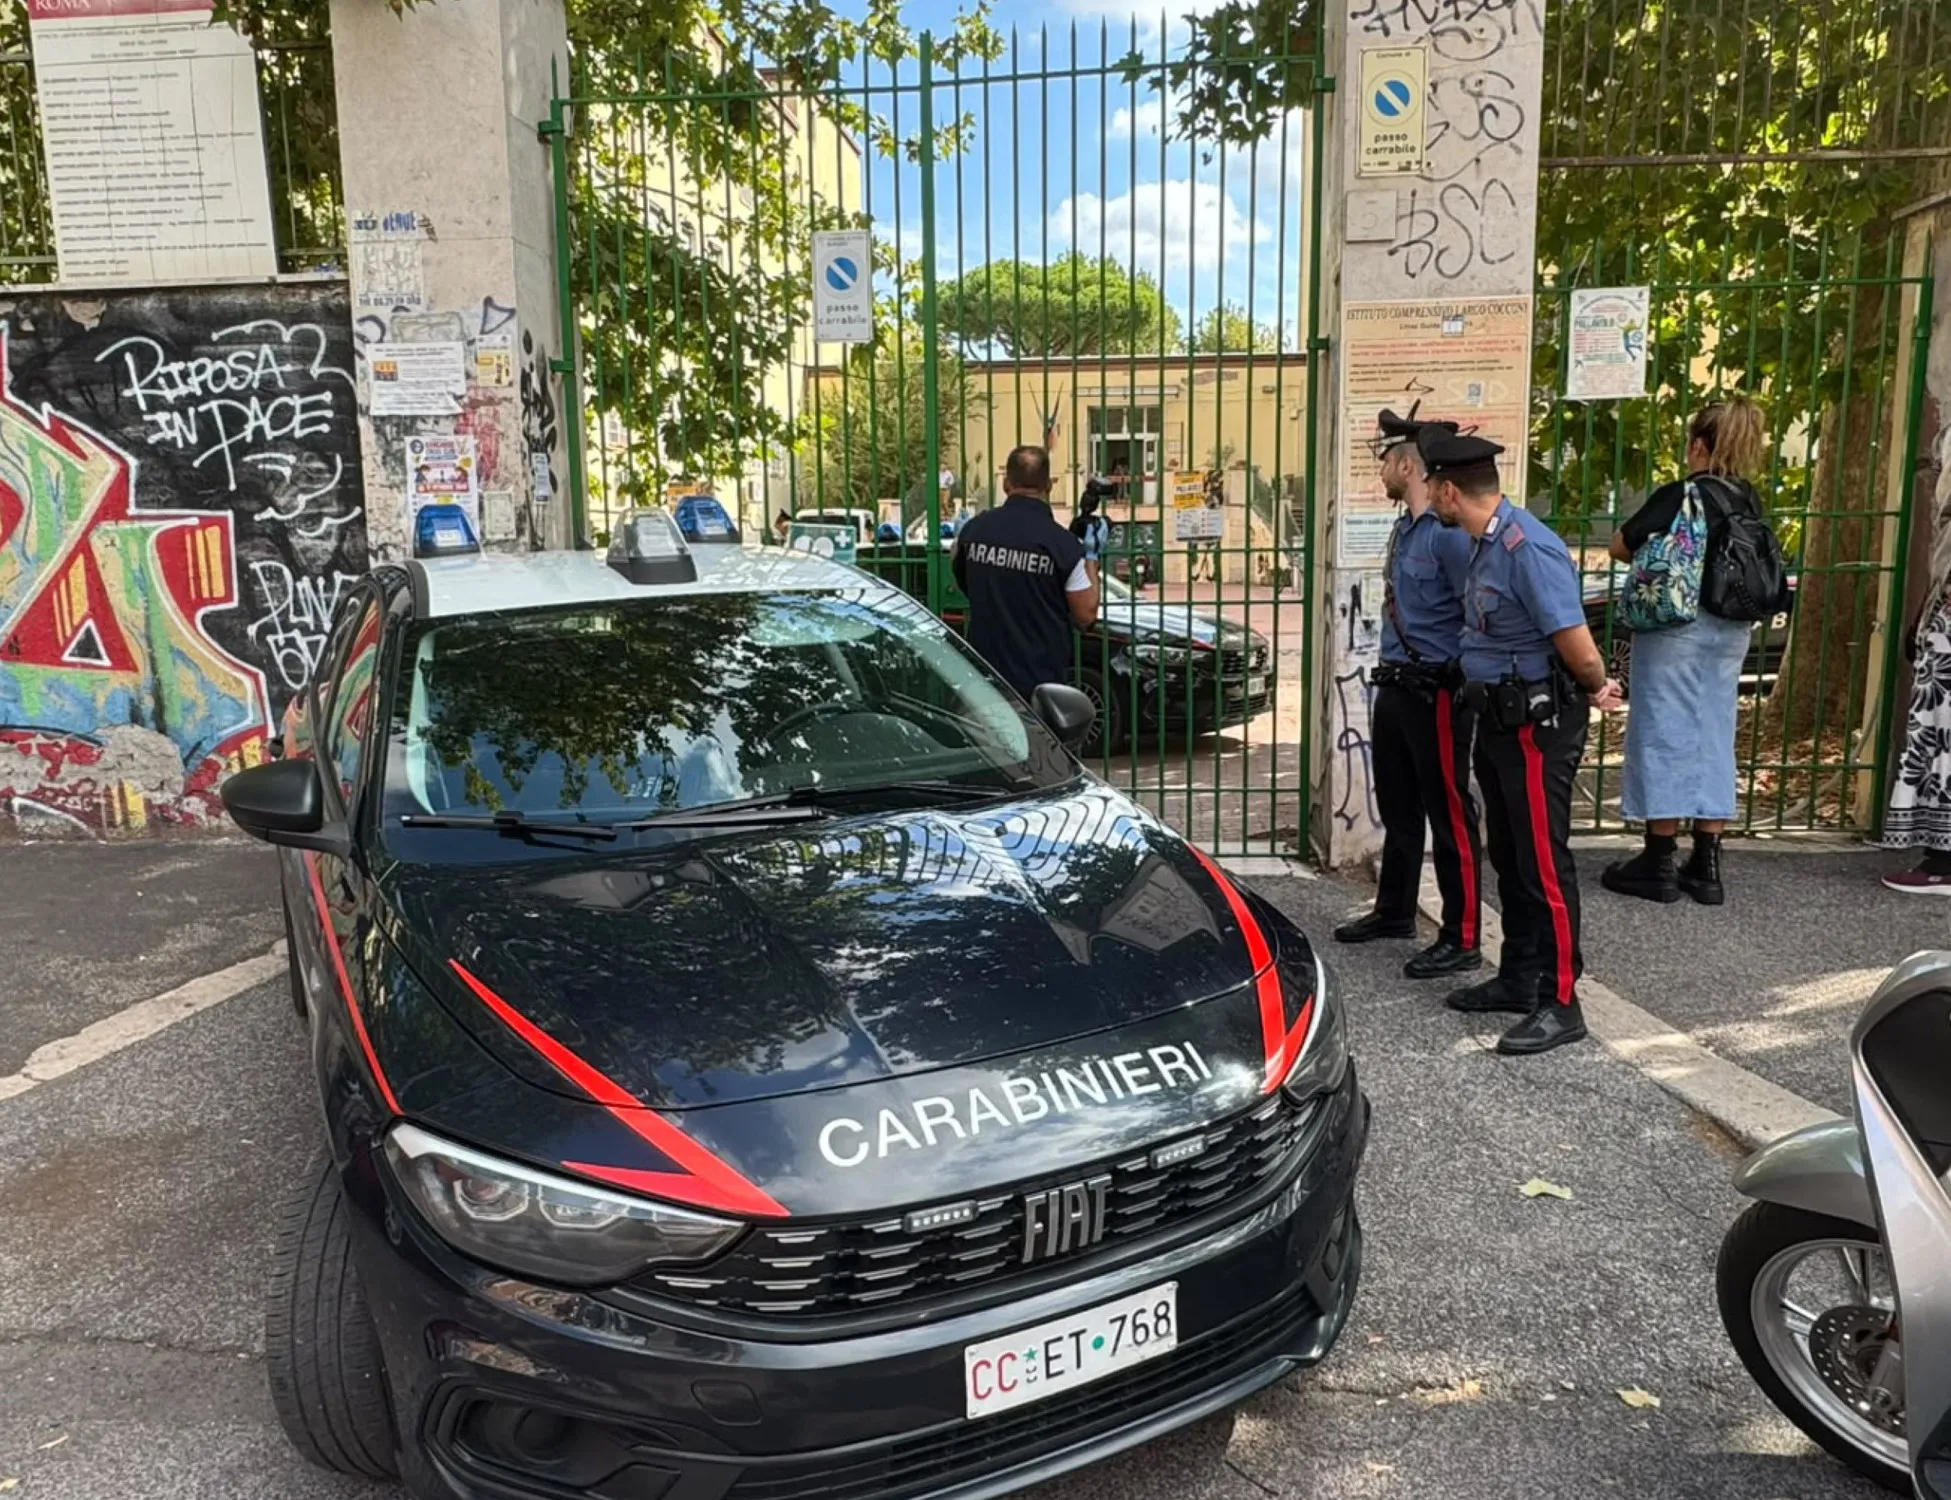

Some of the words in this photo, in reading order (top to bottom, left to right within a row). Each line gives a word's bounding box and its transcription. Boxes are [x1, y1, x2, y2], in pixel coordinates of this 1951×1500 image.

[35, 0, 92, 11] ROMA
[1365, 144, 1416, 156] carrabile
[1374, 133, 1408, 144] passo
[819, 315, 867, 325] carrabile
[826, 304, 859, 315] passo
[95, 336, 293, 411] RIPOSA
[143, 406, 198, 449] IN
[193, 390, 334, 491] PACE
[966, 542, 1055, 576] ARABINIERI
[818, 1041, 1213, 1168] CARABINIERI
[1022, 1174, 1112, 1264] FIAT
[971, 1352, 1018, 1400] CC
[1044, 1328, 1087, 1380] ET
[1109, 1300, 1171, 1357] 768
